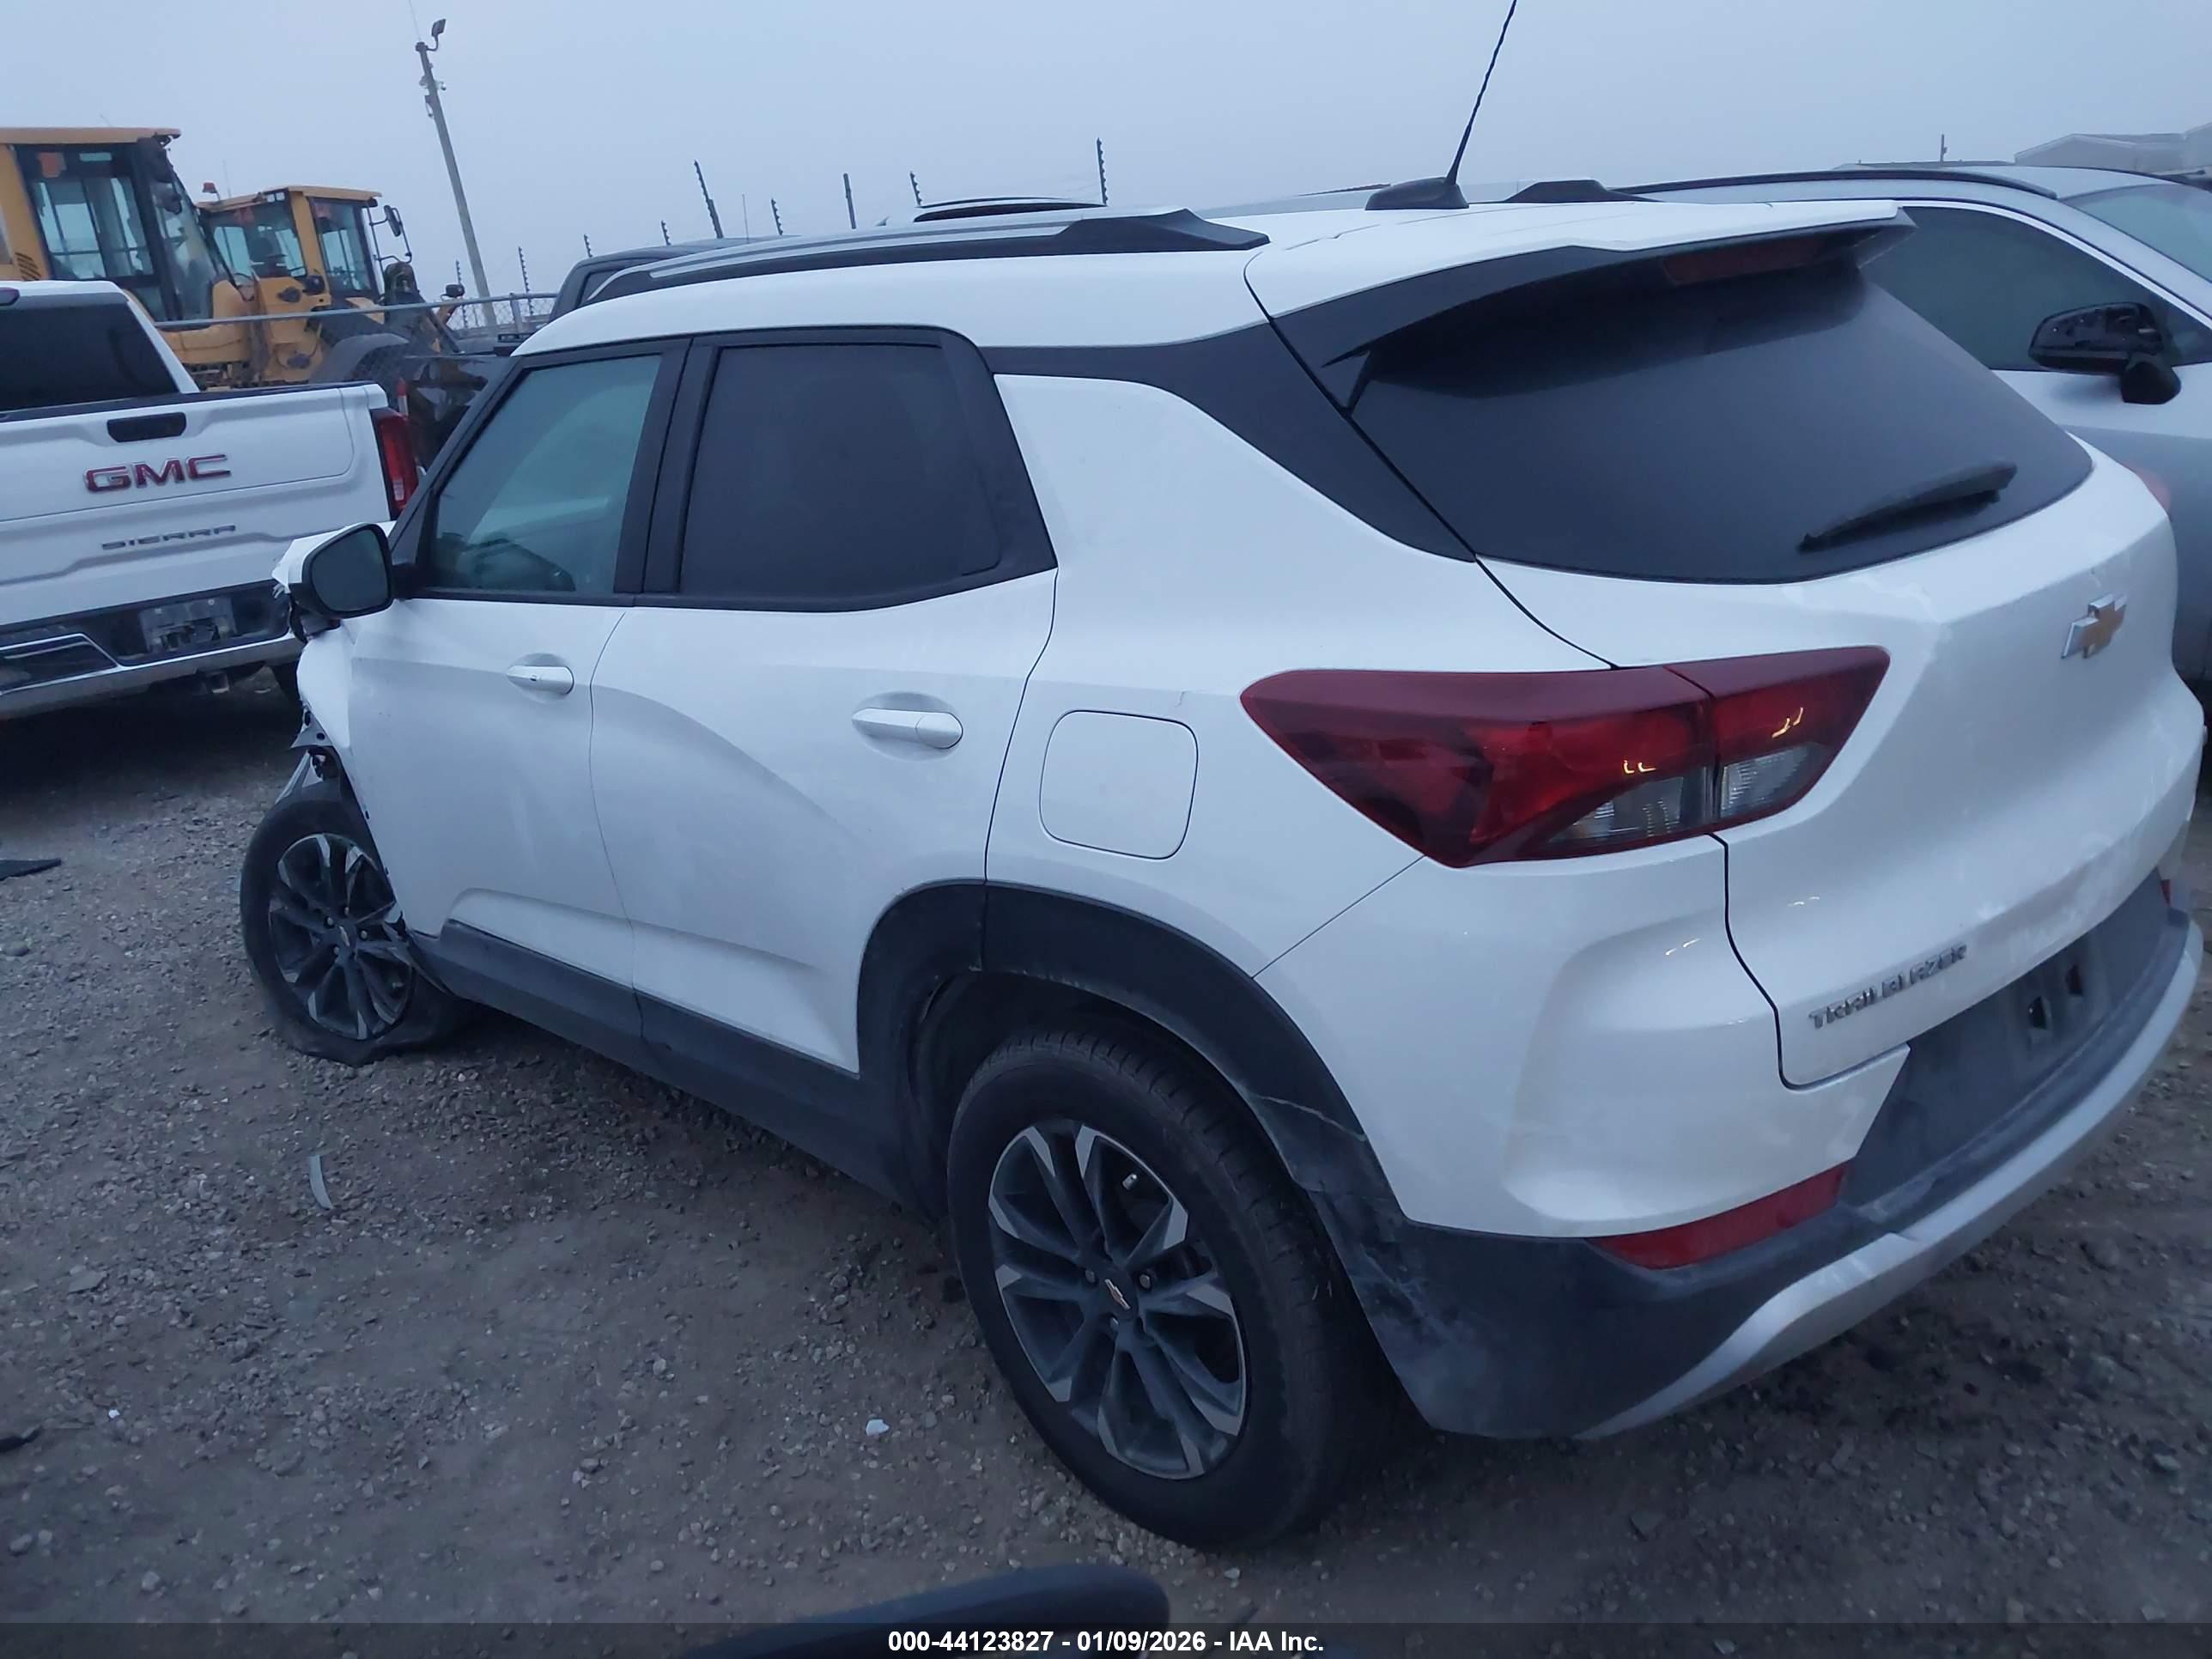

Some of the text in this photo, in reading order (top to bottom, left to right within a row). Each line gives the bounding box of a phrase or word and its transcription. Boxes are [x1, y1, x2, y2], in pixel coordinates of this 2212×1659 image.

[84, 453, 233, 493] GMC
[101, 524, 236, 550] SIERRA
[1808, 943, 1967, 1030] TRAILBLAZER
